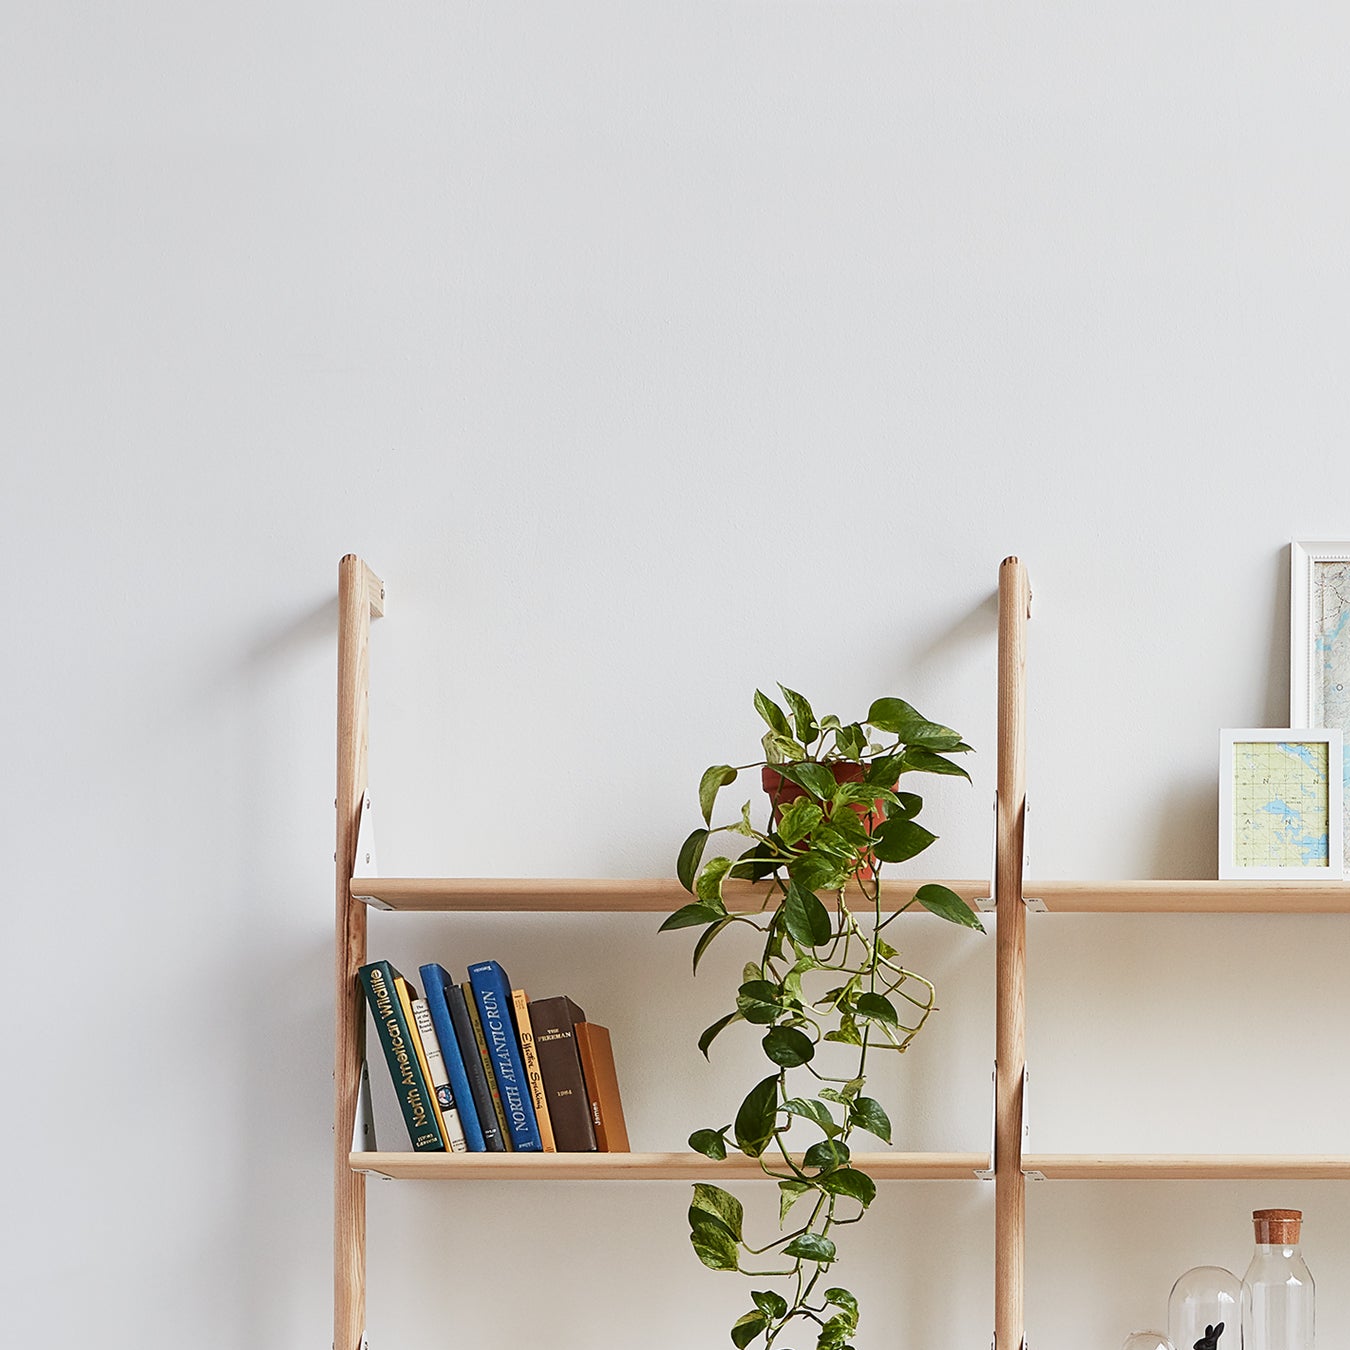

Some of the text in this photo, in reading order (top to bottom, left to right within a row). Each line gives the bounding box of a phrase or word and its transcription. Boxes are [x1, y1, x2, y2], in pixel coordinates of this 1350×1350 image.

[370, 969, 395, 1020] Wildlife
[481, 990, 501, 1019] RUN
[386, 1019, 416, 1085] American
[488, 1020, 517, 1083] ATLANTIC
[537, 1031, 572, 1043] FREEMAN
[521, 1031, 543, 1111] Effective Speaking
[406, 1088, 428, 1128] North
[505, 1086, 529, 1132] NORTH
[592, 1101, 601, 1127] James
